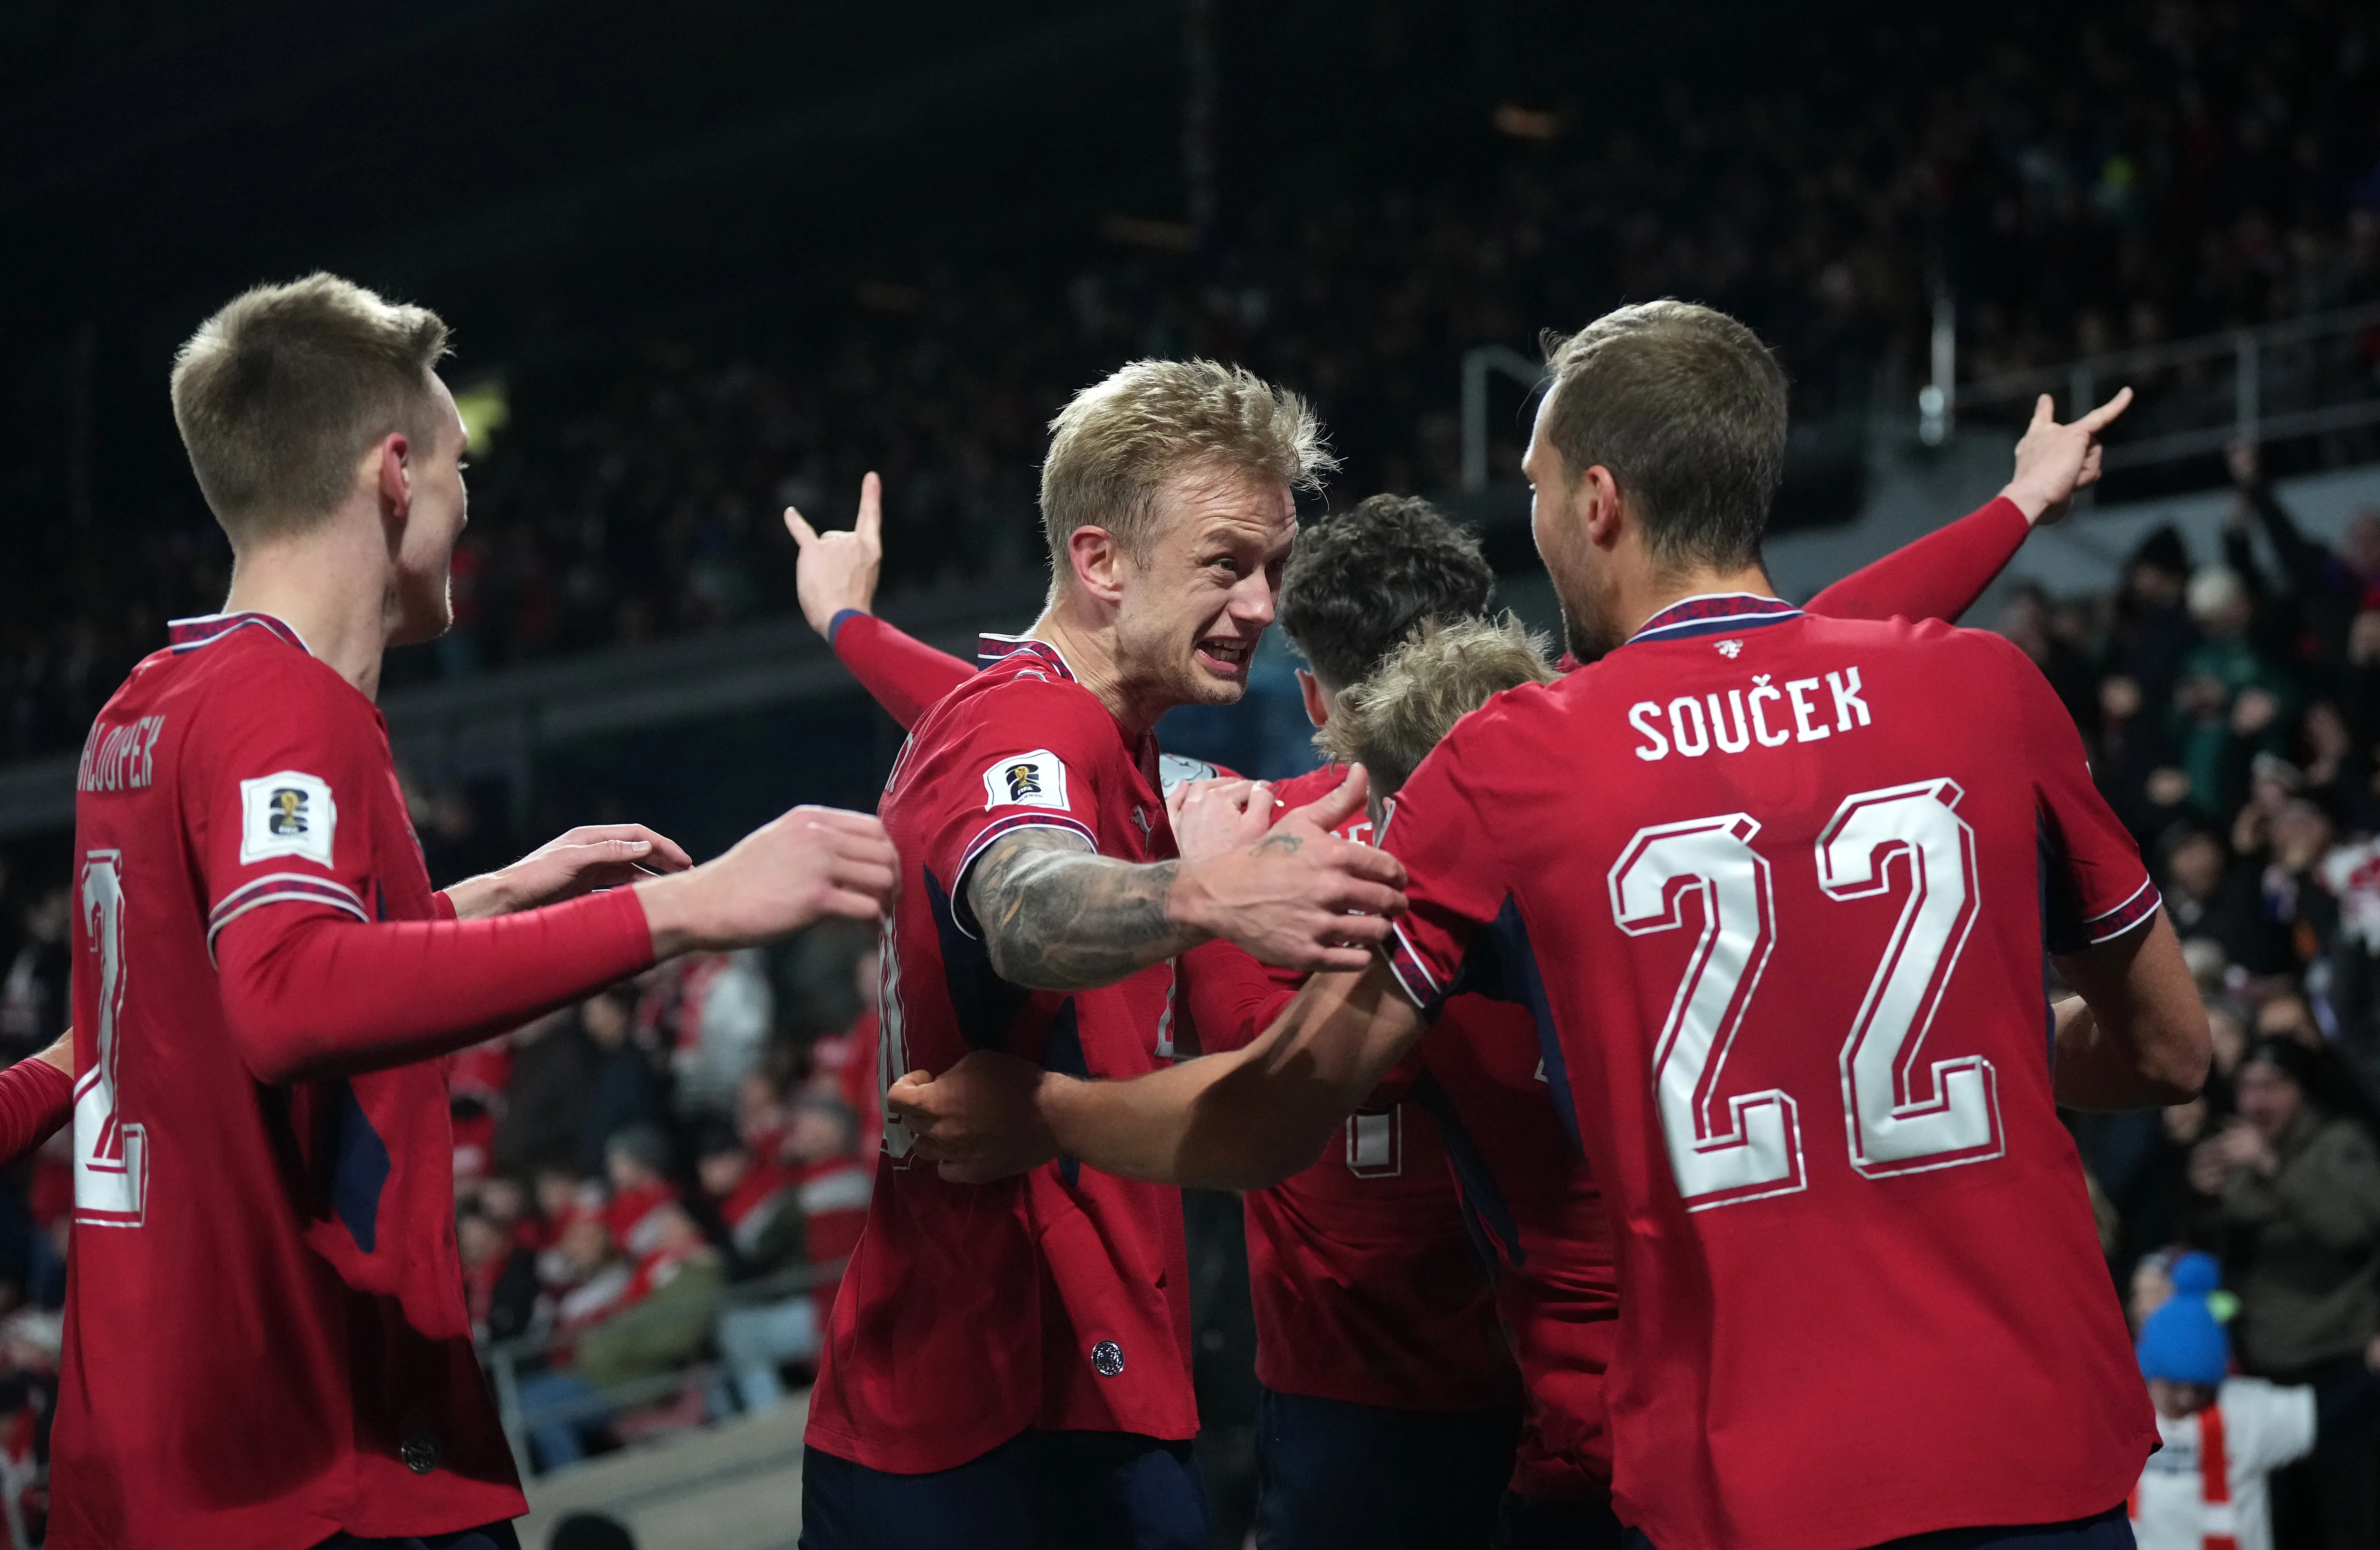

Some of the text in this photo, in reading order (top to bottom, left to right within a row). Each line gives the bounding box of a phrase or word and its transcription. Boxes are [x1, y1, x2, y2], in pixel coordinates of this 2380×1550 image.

[1628, 666, 1872, 762] SOUČEK
[1014, 793, 1043, 805] UALIFIERS
[1017, 785, 1034, 796] FIFA
[73, 848, 148, 1227] 2
[1607, 776, 2005, 1213] 22
